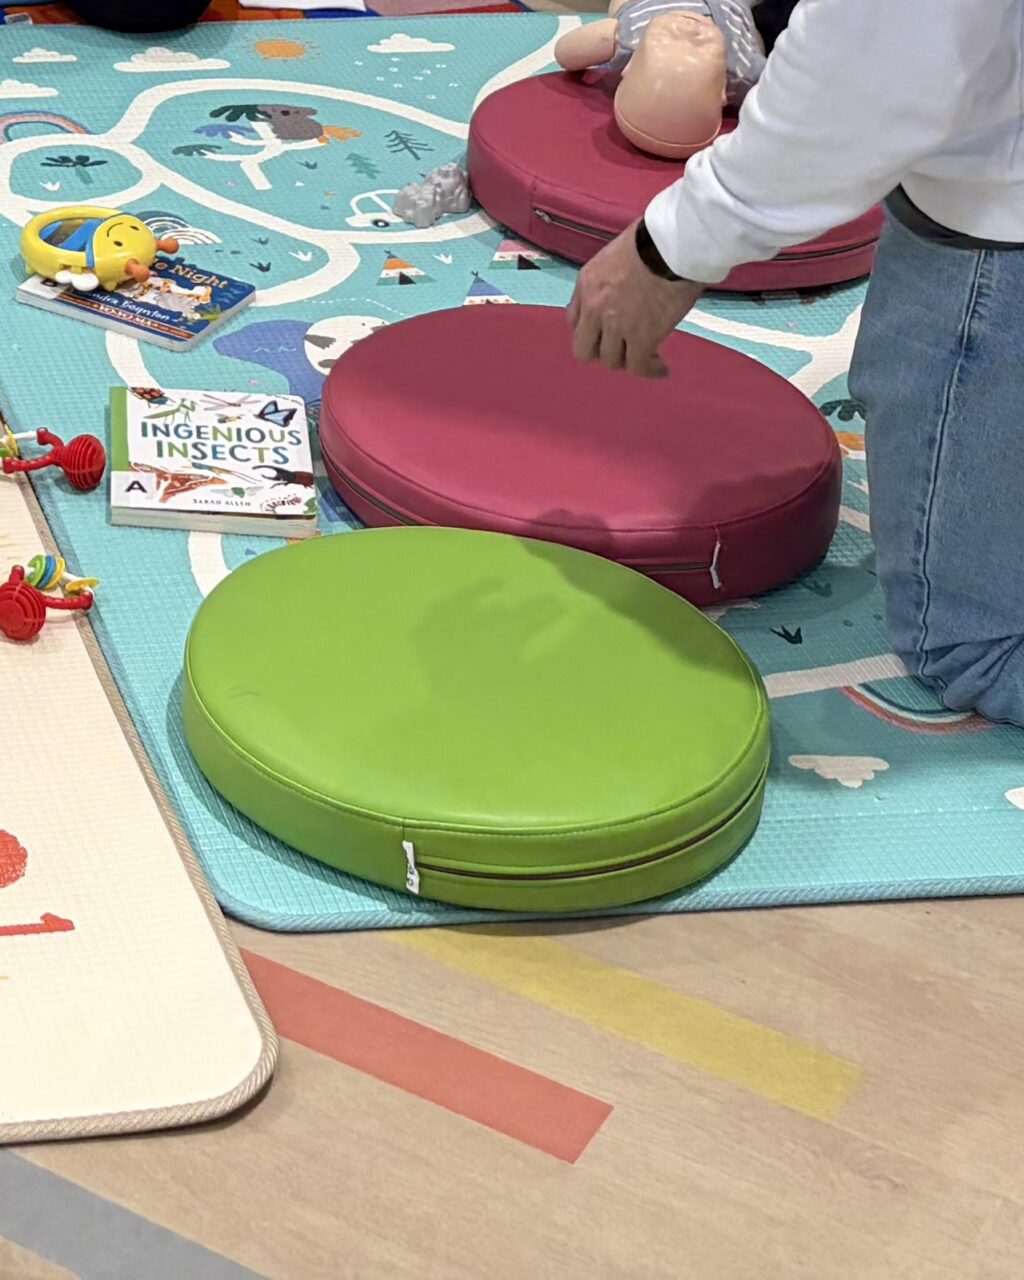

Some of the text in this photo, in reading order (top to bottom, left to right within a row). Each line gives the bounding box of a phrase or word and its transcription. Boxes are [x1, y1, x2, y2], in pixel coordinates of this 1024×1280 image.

[171, 264, 229, 290] Night
[121, 300, 170, 321] Boynton
[141, 421, 302, 446] INGENIOUS
[157, 440, 290, 465] INSECTS
[124, 480, 147, 493] A
